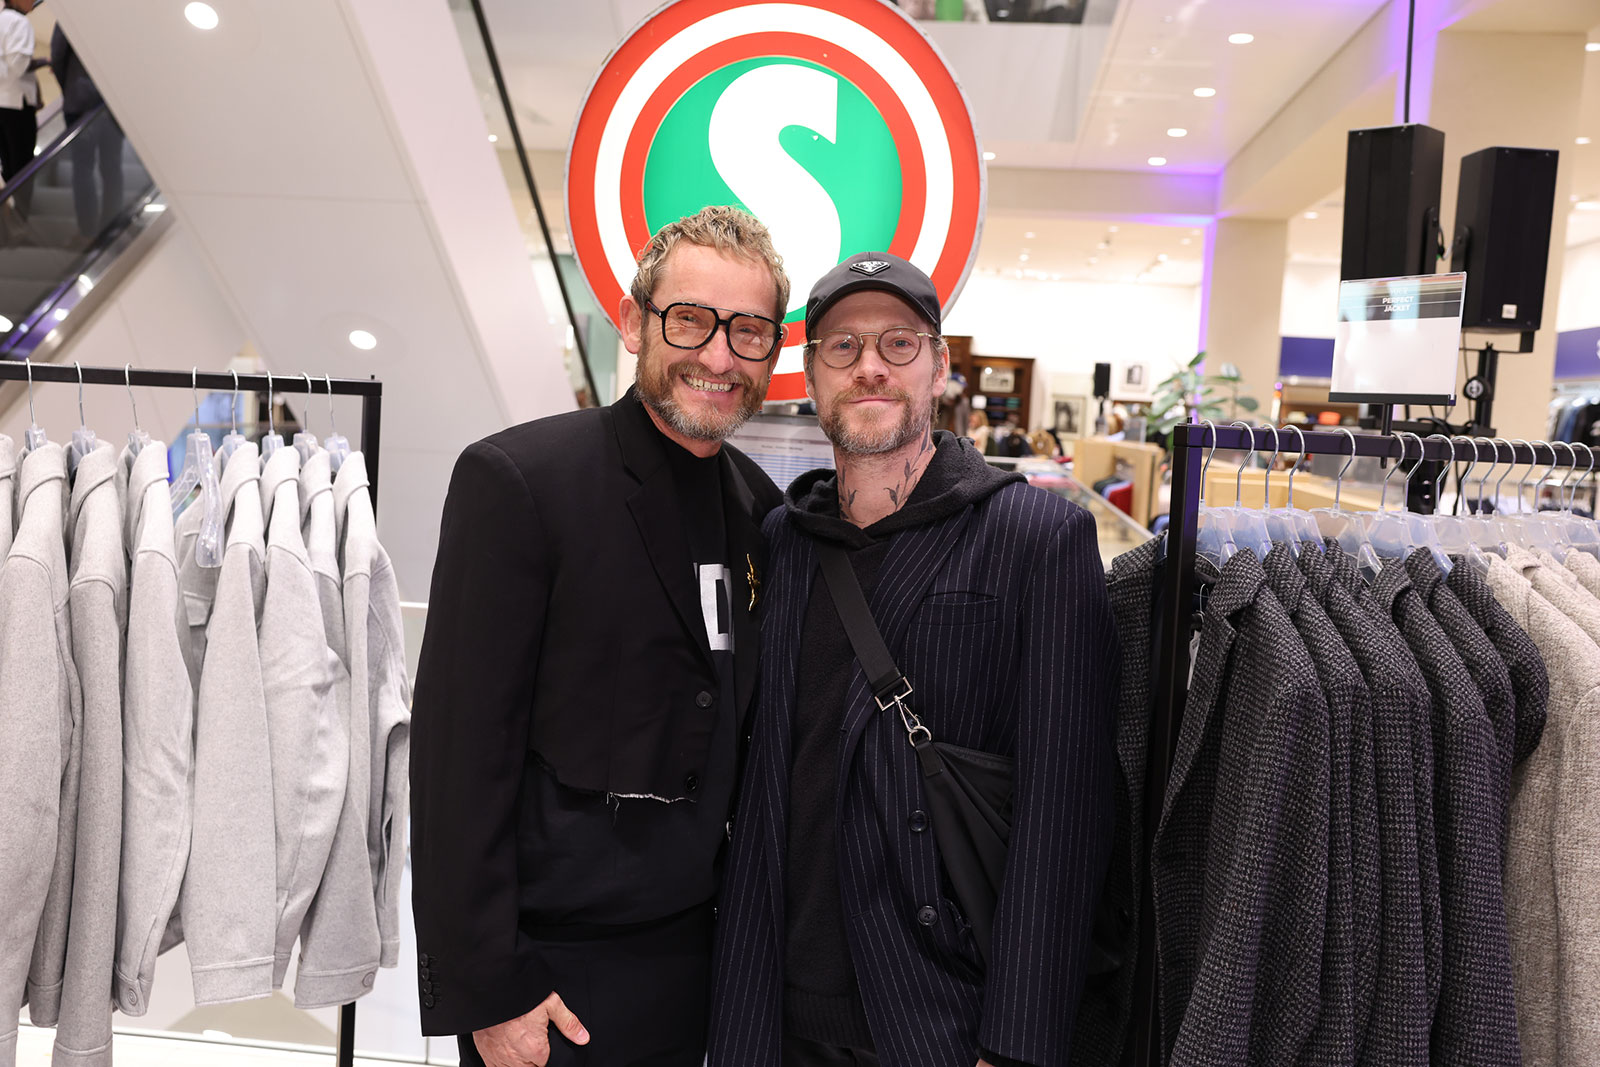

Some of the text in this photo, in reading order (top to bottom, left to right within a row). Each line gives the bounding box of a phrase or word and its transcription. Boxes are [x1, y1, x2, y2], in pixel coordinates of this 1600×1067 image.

[708, 63, 842, 314] S
[1382, 296, 1414, 304] PERFECT
[1384, 304, 1411, 312] JACKET
